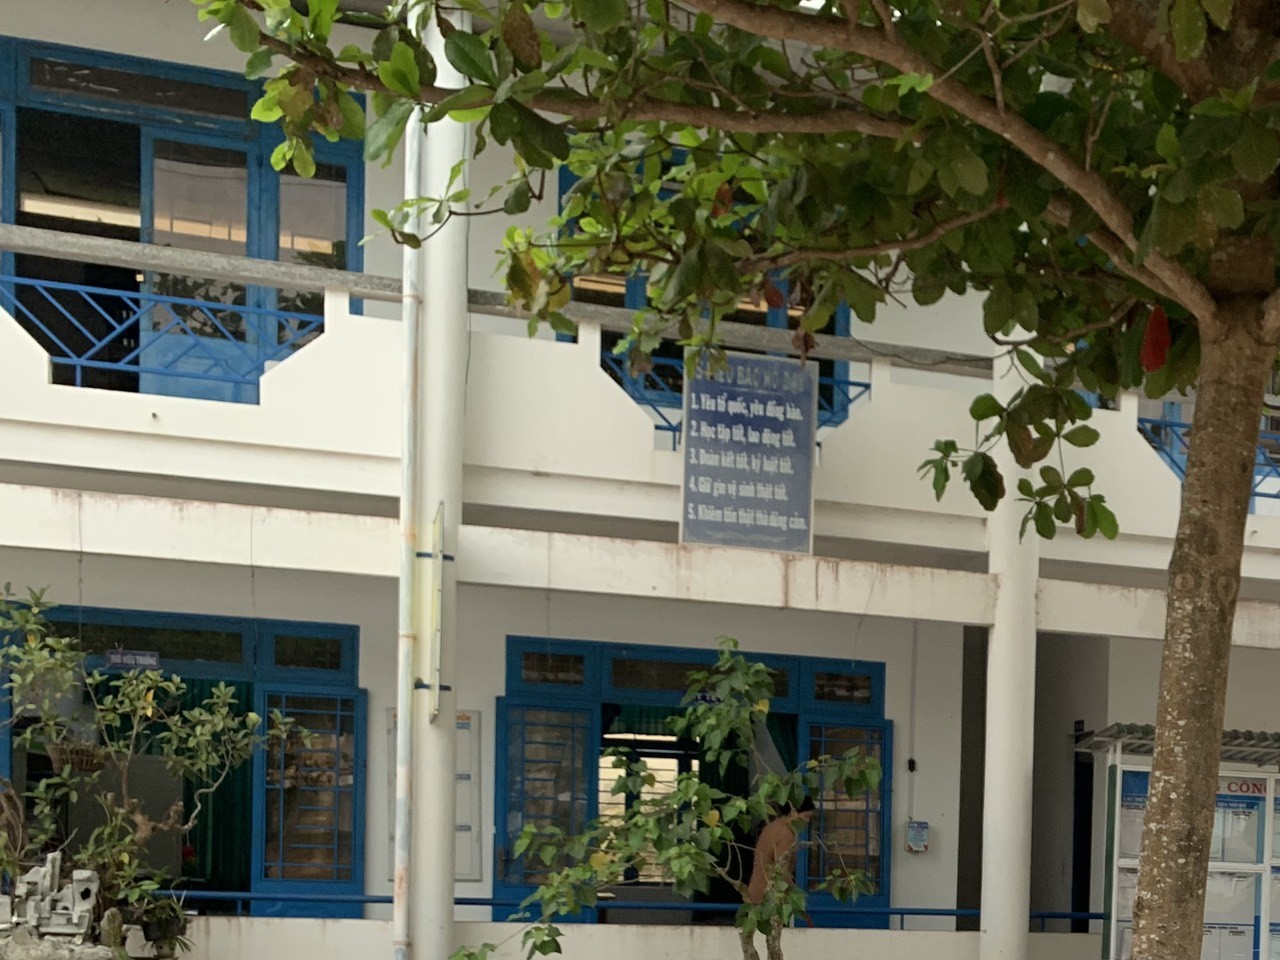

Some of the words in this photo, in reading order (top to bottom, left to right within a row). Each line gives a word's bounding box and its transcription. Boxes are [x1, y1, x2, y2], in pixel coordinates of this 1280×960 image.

[691, 392, 700, 410] 1.
[690, 420, 699, 437] 2.
[690, 447, 699, 465] 3.
[688, 475, 698, 492] 4.
[687, 502, 697, 520] 5.
[1227, 780, 1267, 795] CÔN
